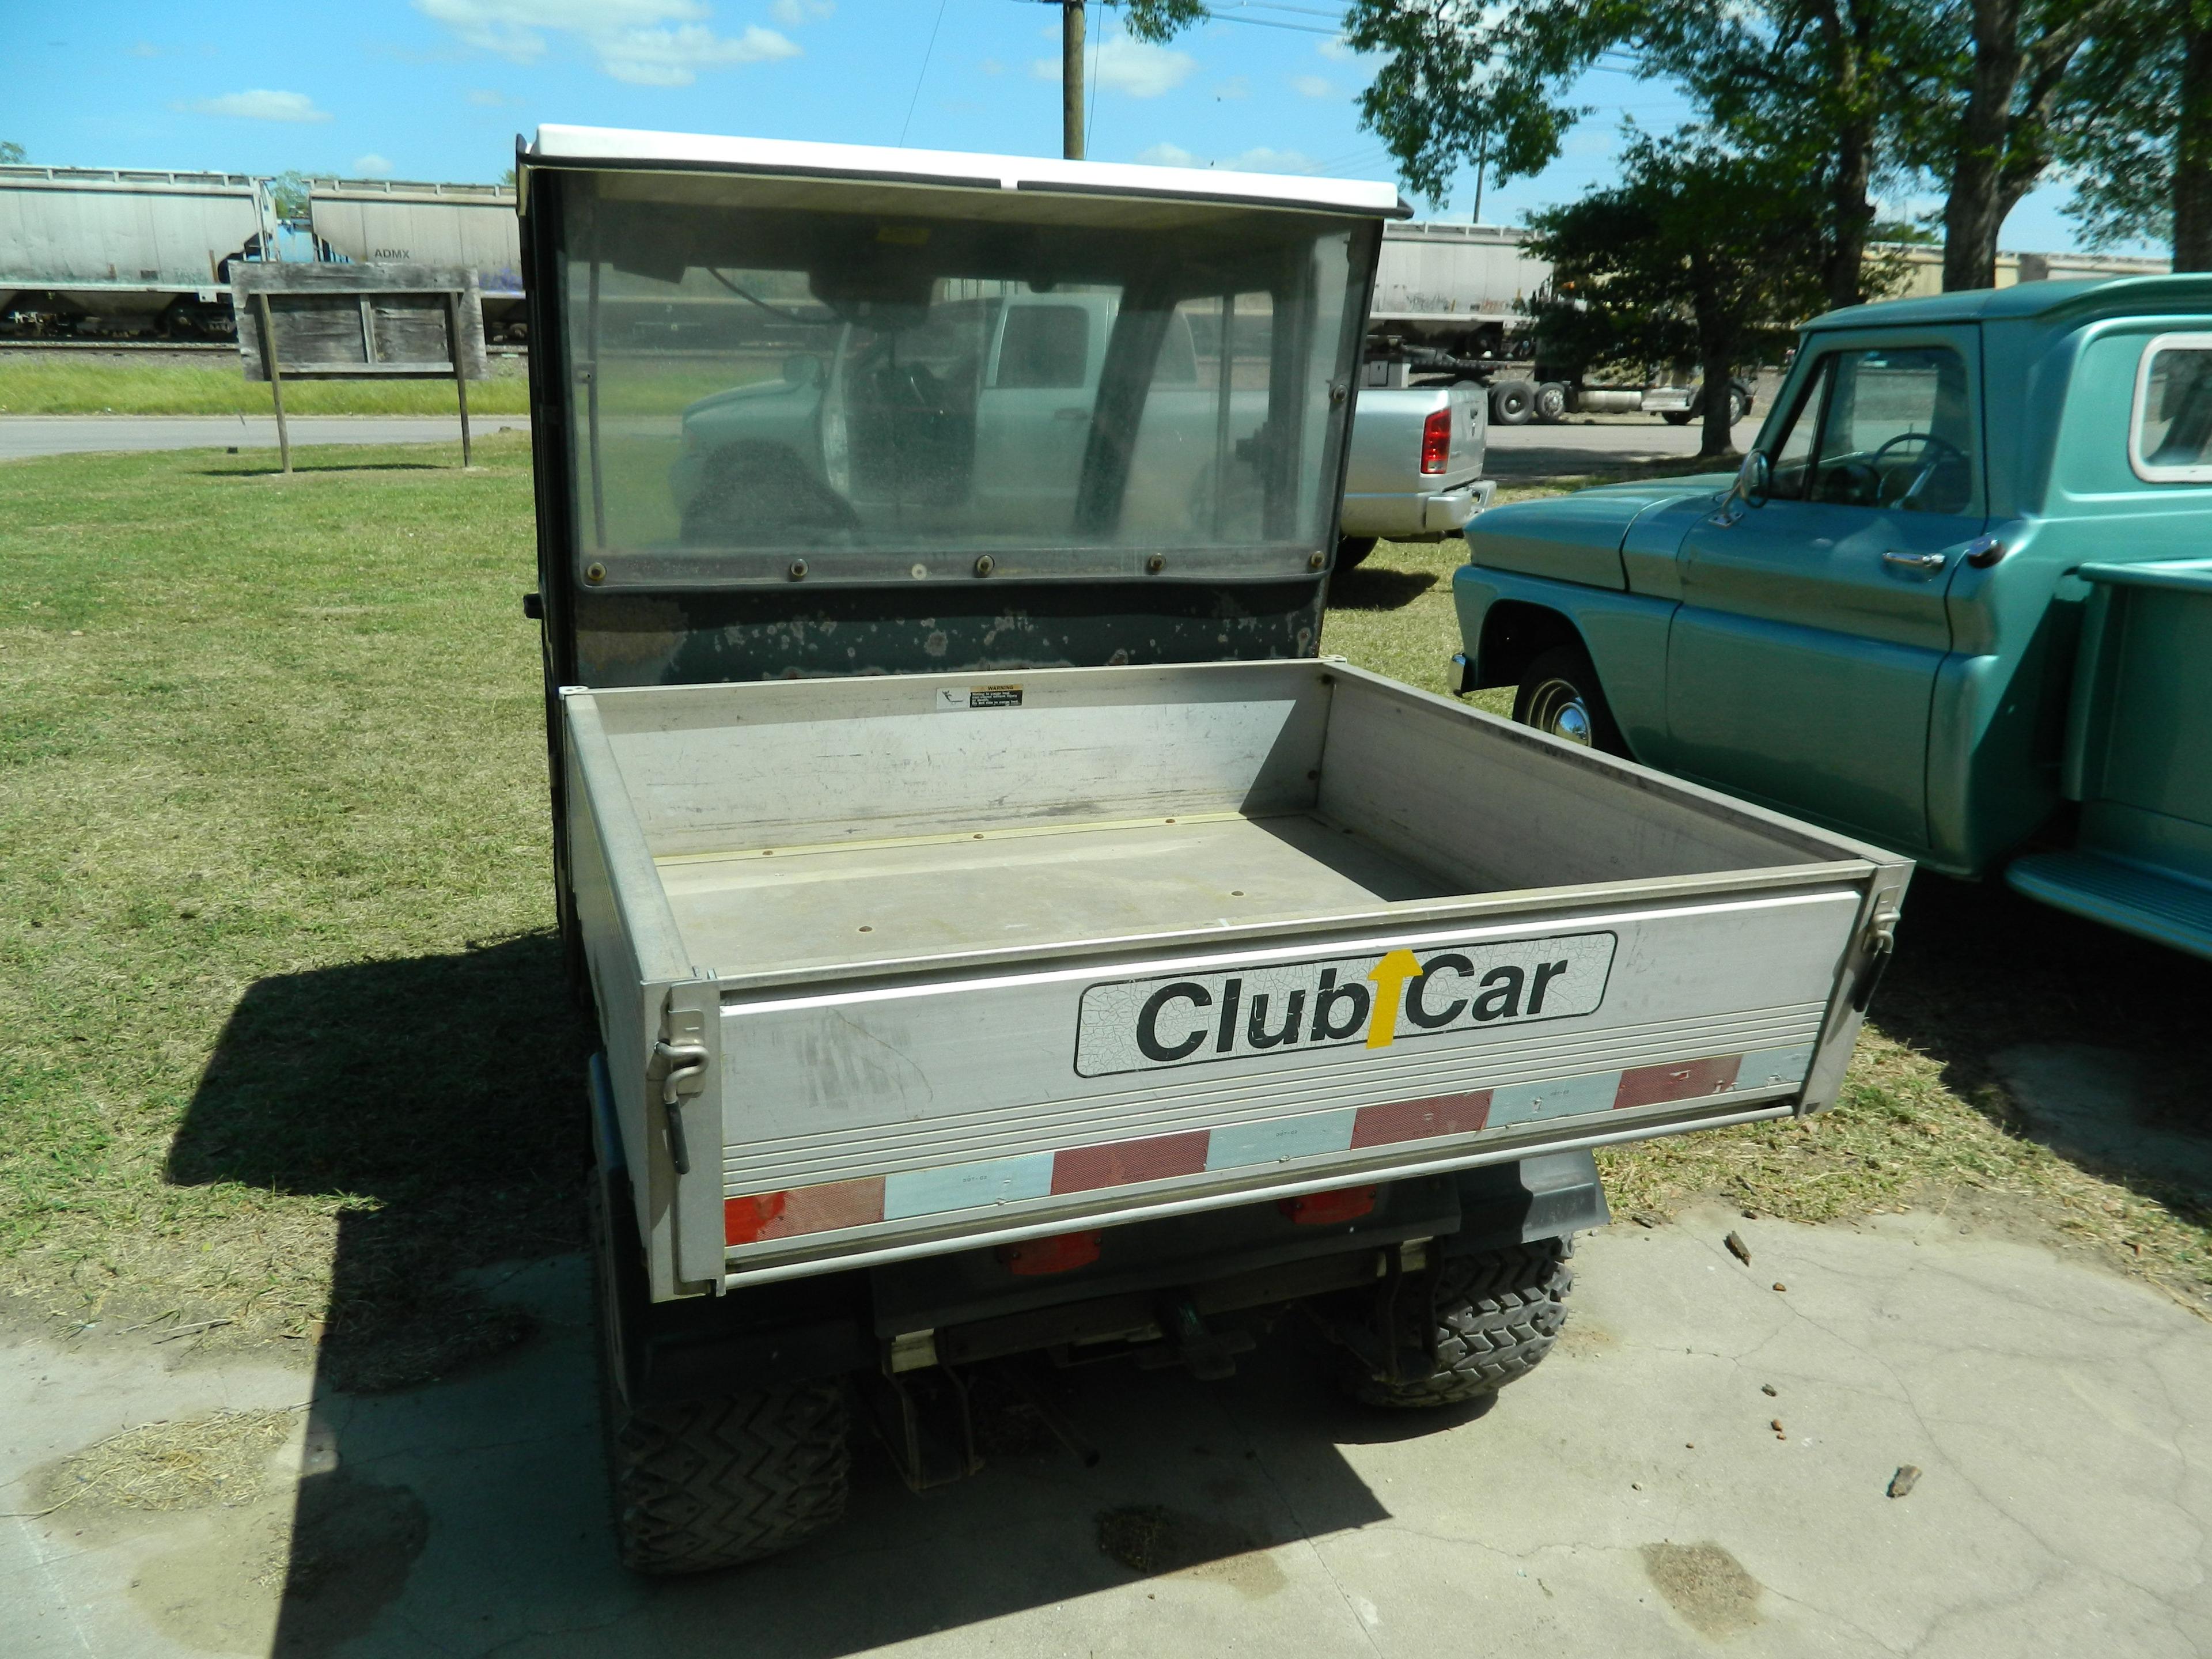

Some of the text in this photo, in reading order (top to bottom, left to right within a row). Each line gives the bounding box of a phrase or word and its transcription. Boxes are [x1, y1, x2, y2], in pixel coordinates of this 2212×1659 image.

[375, 249, 410, 259] ADMX
[1136, 953, 1568, 1062] Club Car
